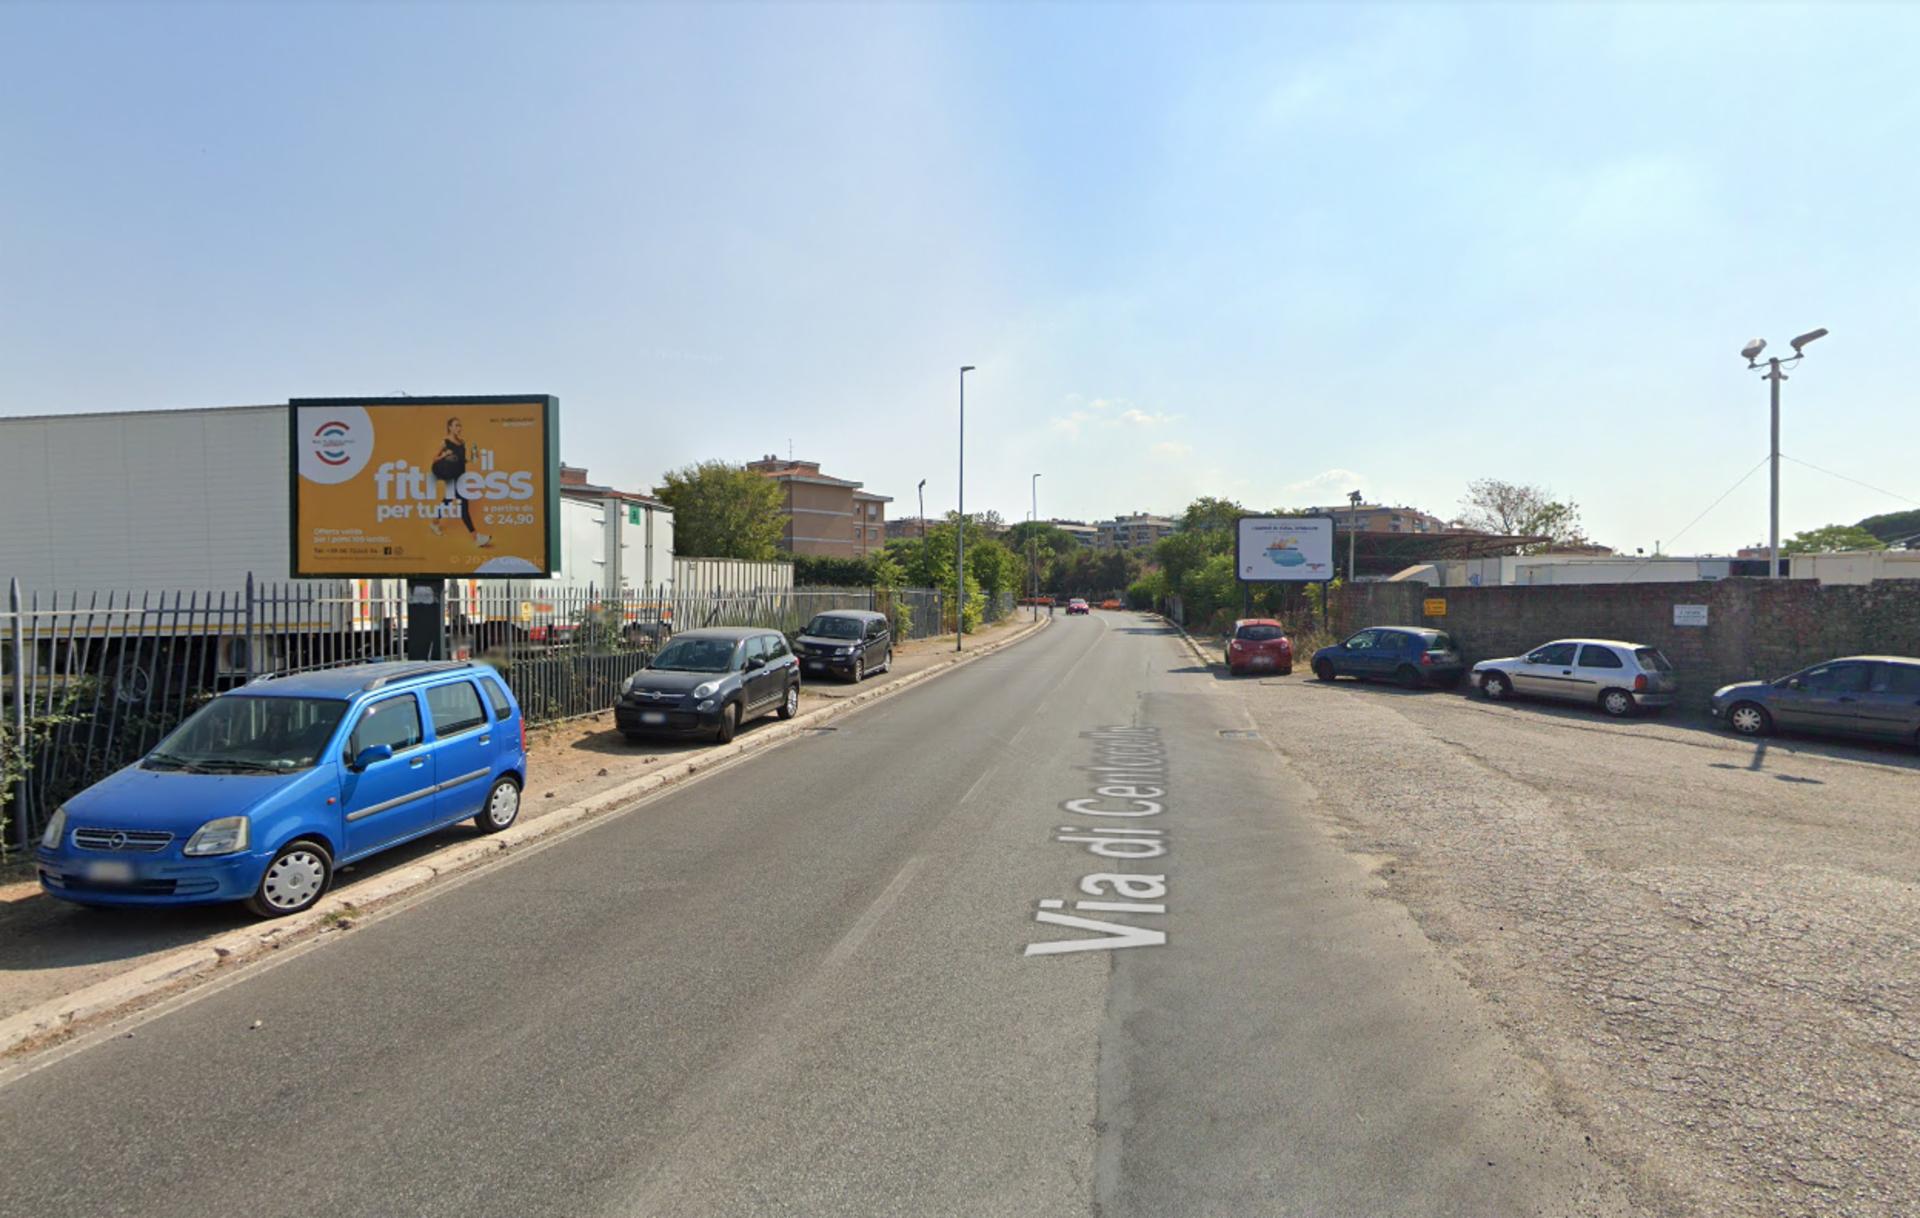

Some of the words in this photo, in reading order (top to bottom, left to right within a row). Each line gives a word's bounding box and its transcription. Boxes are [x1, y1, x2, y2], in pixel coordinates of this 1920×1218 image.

[481, 449, 495, 471] il
[374, 459, 534, 501] fitness
[377, 503, 413, 523] per
[417, 499, 463, 519] tutti
[497, 514, 534, 526] 24,90
